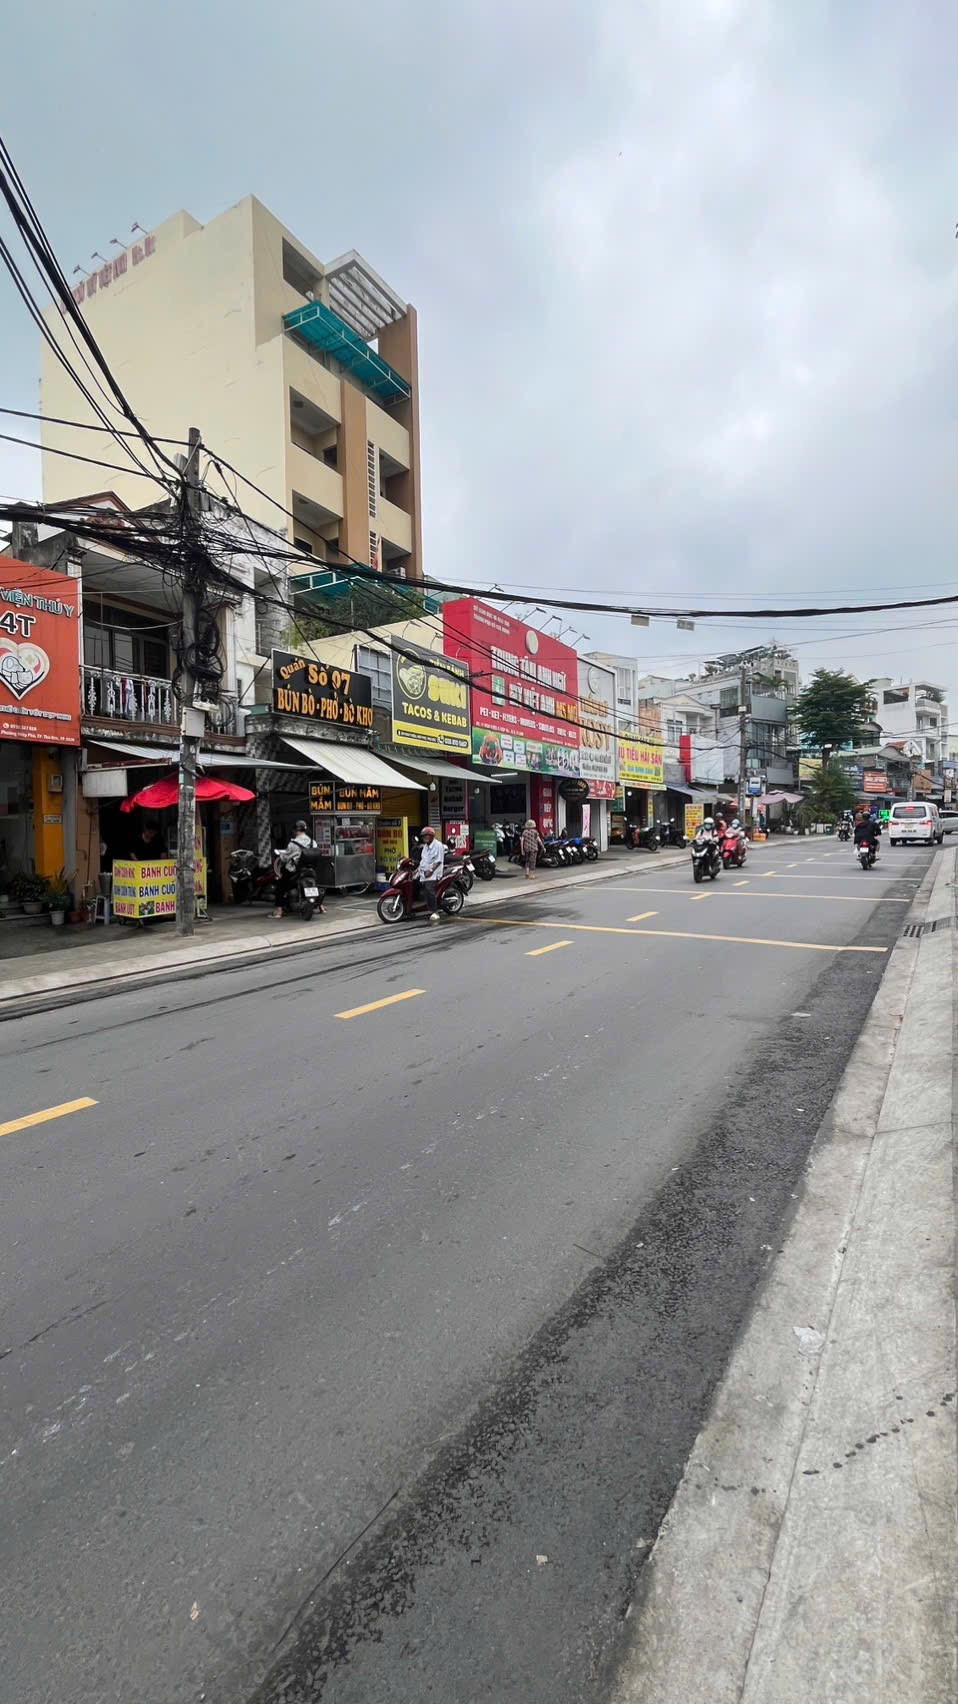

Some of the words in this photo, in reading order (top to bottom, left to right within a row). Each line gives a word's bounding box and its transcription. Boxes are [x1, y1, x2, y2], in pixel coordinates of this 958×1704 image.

[63, 604, 74, 618] Y
[0, 611, 35, 638] 4T
[331, 670, 351, 695] 97
[277, 684, 300, 713] BÚN
[301, 688, 315, 716] BÒ
[343, 698, 355, 723] BÒ
[356, 705, 373, 727] KHO
[402, 702, 432, 720] TACOS
[433, 710, 440, 722] &
[441, 711, 467, 728] KEBAB
[312, 784, 330, 796] BÚN
[141, 864, 161, 879] BÁNH
[139, 882, 159, 897] BÁNH
[155, 898, 175, 913] BÁNH
